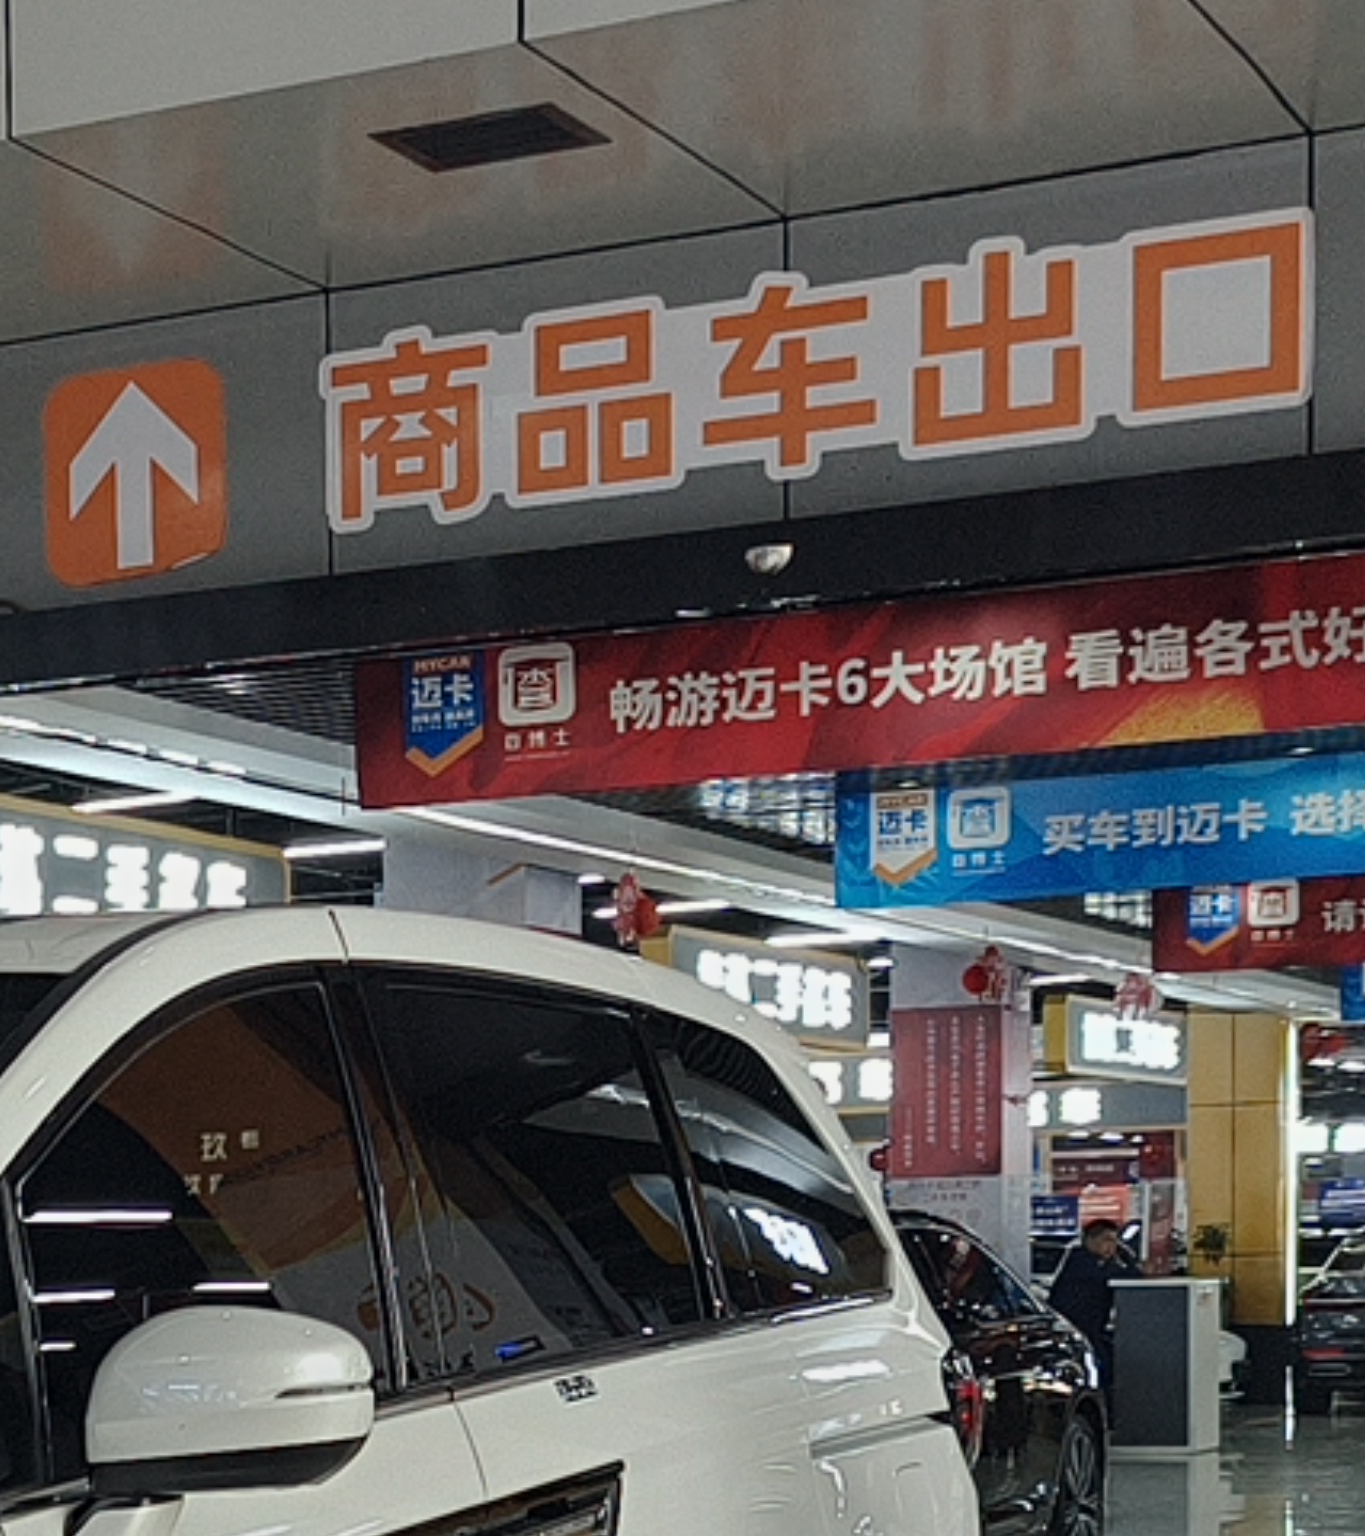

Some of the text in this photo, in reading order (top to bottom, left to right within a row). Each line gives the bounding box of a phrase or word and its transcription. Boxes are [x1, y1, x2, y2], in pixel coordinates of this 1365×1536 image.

[327, 215, 1311, 532] 商品车出口
[411, 673, 474, 709] 迈卡
[609, 604, 1365, 733] 畅游迈卡6大场馆 看遍各式好
[1043, 799, 1268, 856] 买车到迈卡
[1321, 898, 1365, 933] 请
